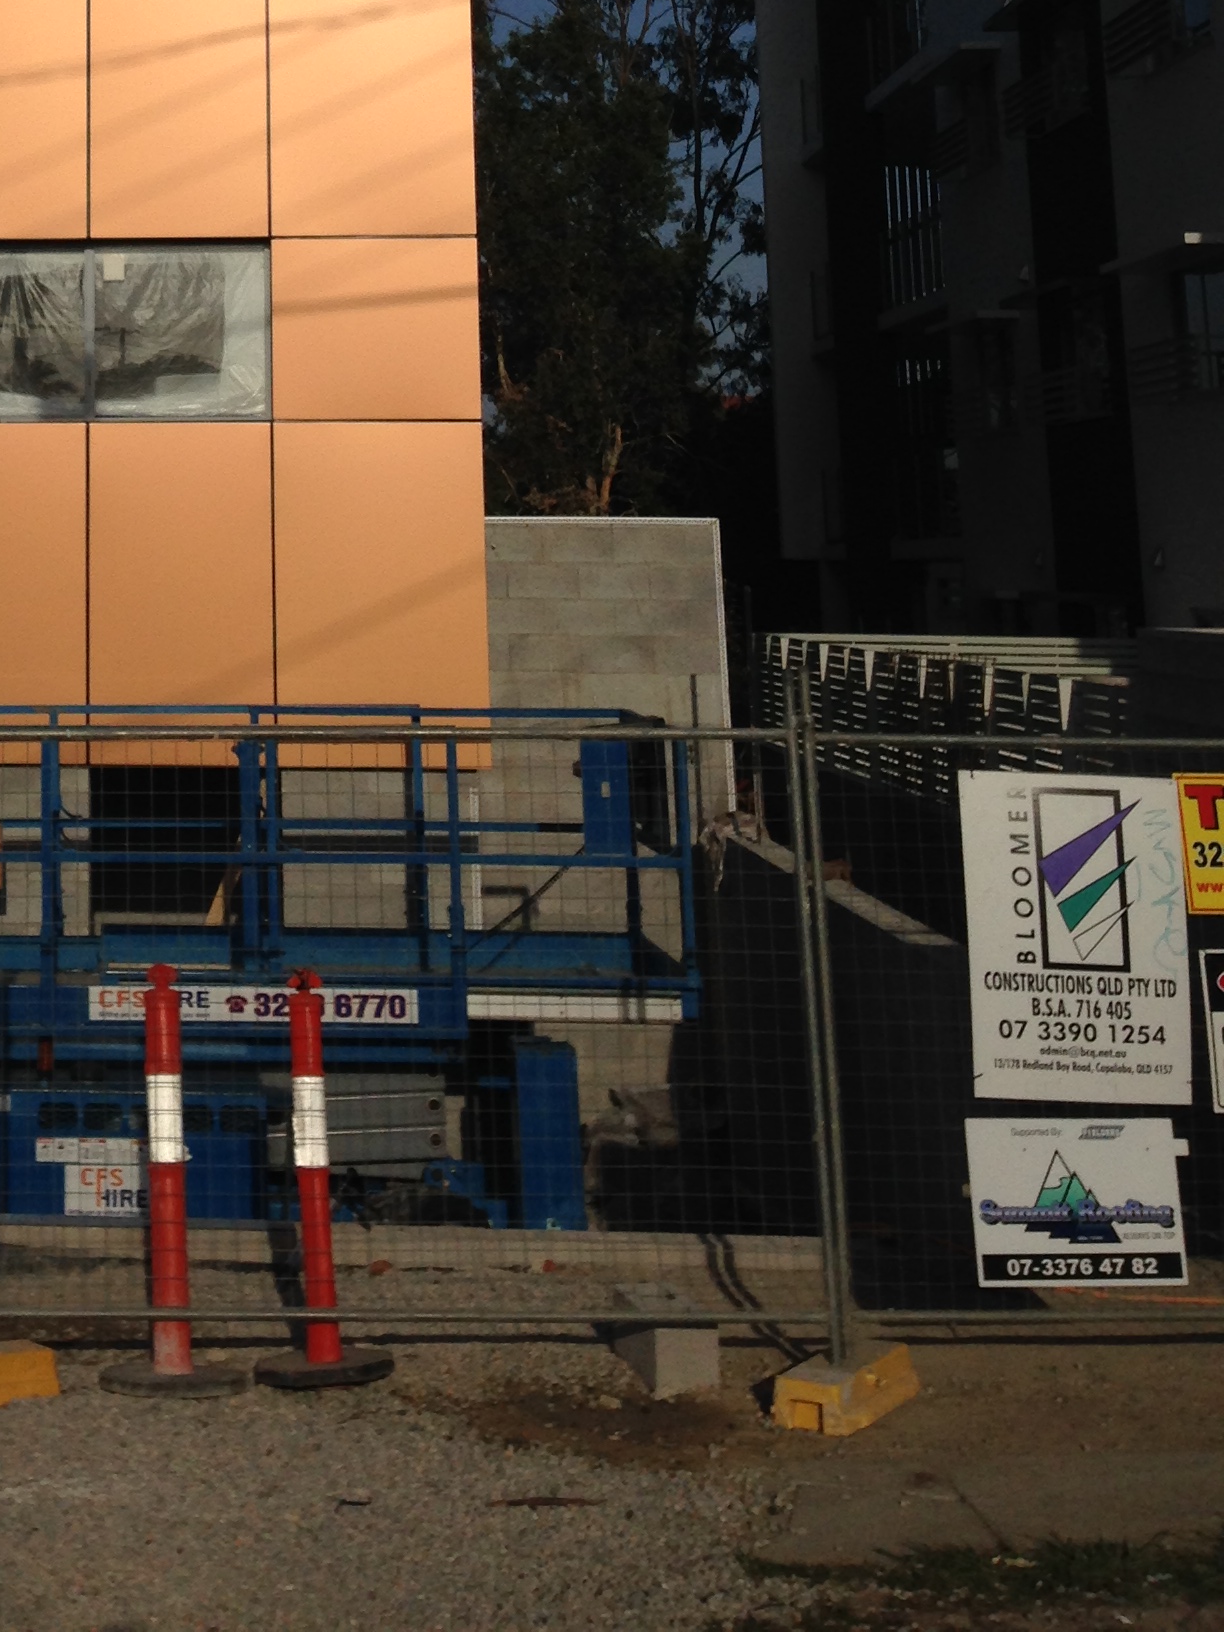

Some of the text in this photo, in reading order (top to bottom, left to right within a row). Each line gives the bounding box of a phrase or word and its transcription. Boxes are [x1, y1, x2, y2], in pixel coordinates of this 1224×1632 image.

[1007, 786, 1037, 965] BLOOMER
[1196, 882, 1224, 893] ww
[984, 972, 1177, 998] CONSTRUCTIONS QLD PTY LTD
[99, 990, 145, 1008] CFS
[254, 993, 325, 1017] 32
[335, 995, 406, 1018] 6770
[1032, 999, 1132, 1021] B.S.A. 716 405
[998, 1020, 1167, 1045] 07 3390 1254
[1056, 1061, 1071, 1073] Bay
[1136, 1063, 1152, 1074] QLD
[80, 1167, 124, 1188] CFS
[97, 1188, 148, 1208] HIRE
[1006, 1257, 1159, 1276] 07-3376 47 82
